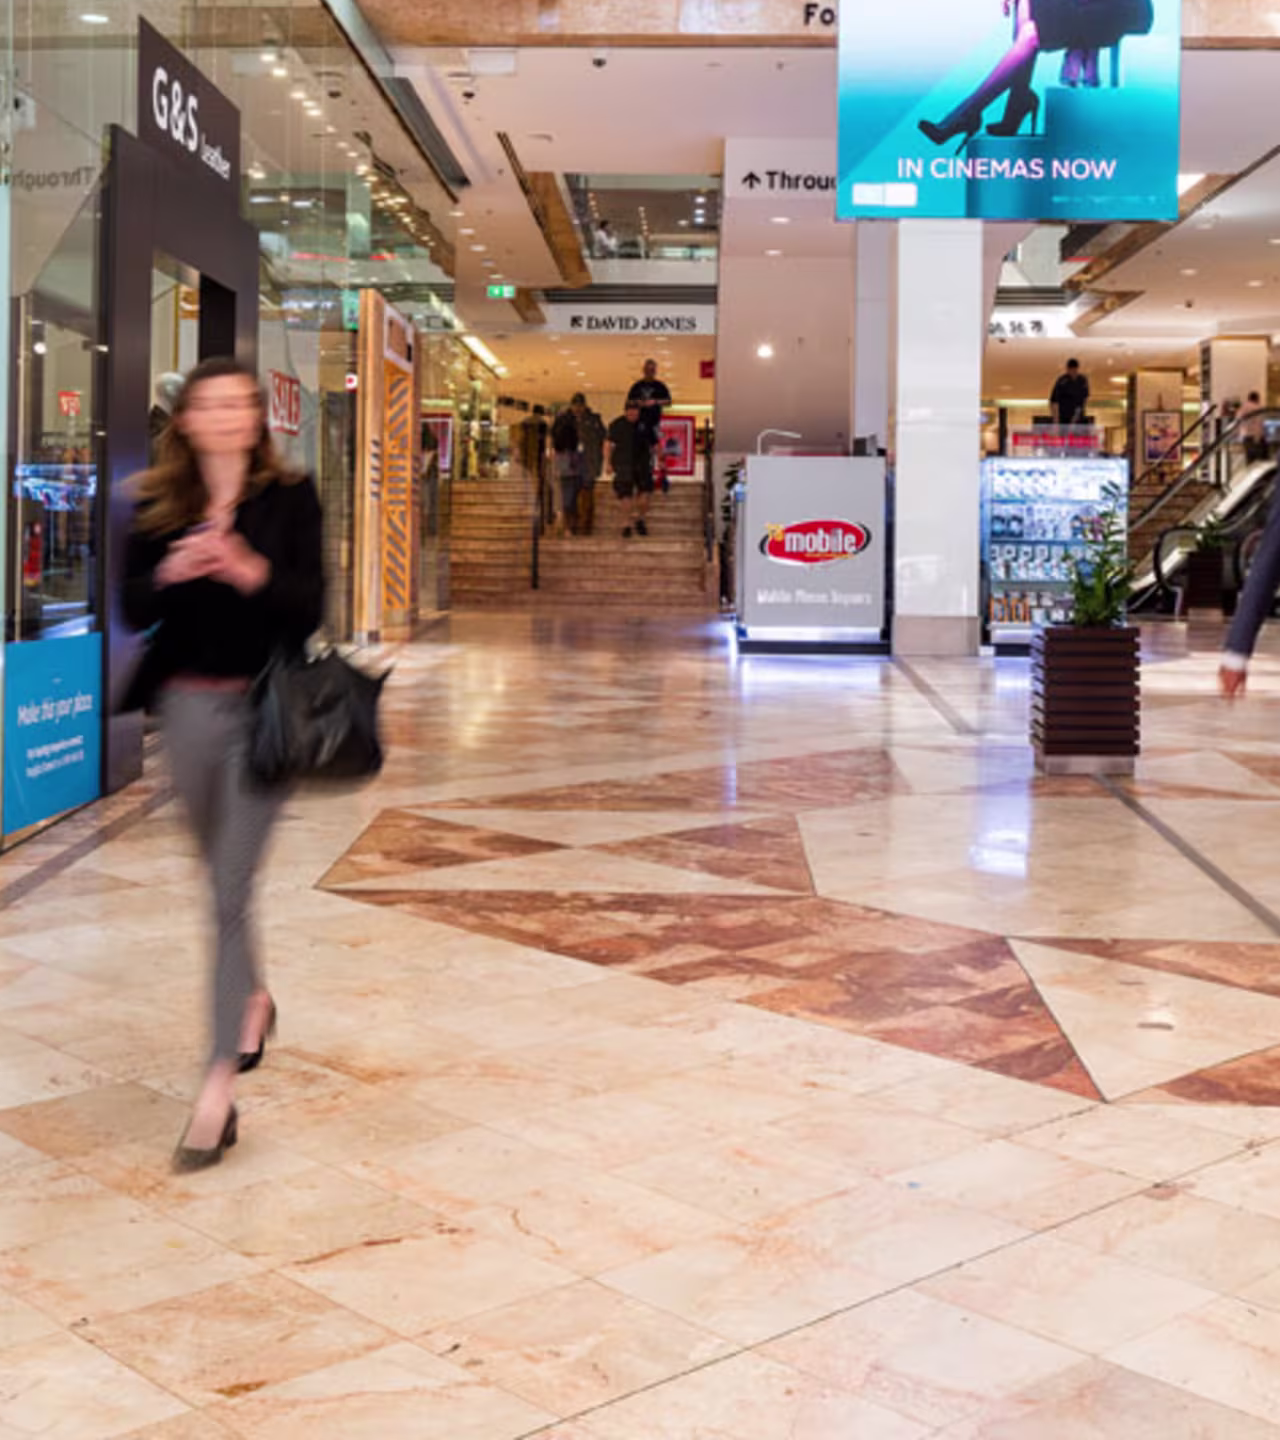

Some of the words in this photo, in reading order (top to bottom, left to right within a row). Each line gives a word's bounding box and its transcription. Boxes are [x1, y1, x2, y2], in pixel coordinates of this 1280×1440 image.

[152, 66, 199, 153] G&S
[897, 157, 925, 179] IN
[930, 157, 1045, 180] CINEMAS
[1051, 157, 1118, 180] NOW
[586, 315, 638, 331] DAVID
[641, 315, 697, 331] JONES
[784, 527, 857, 553] mobile
